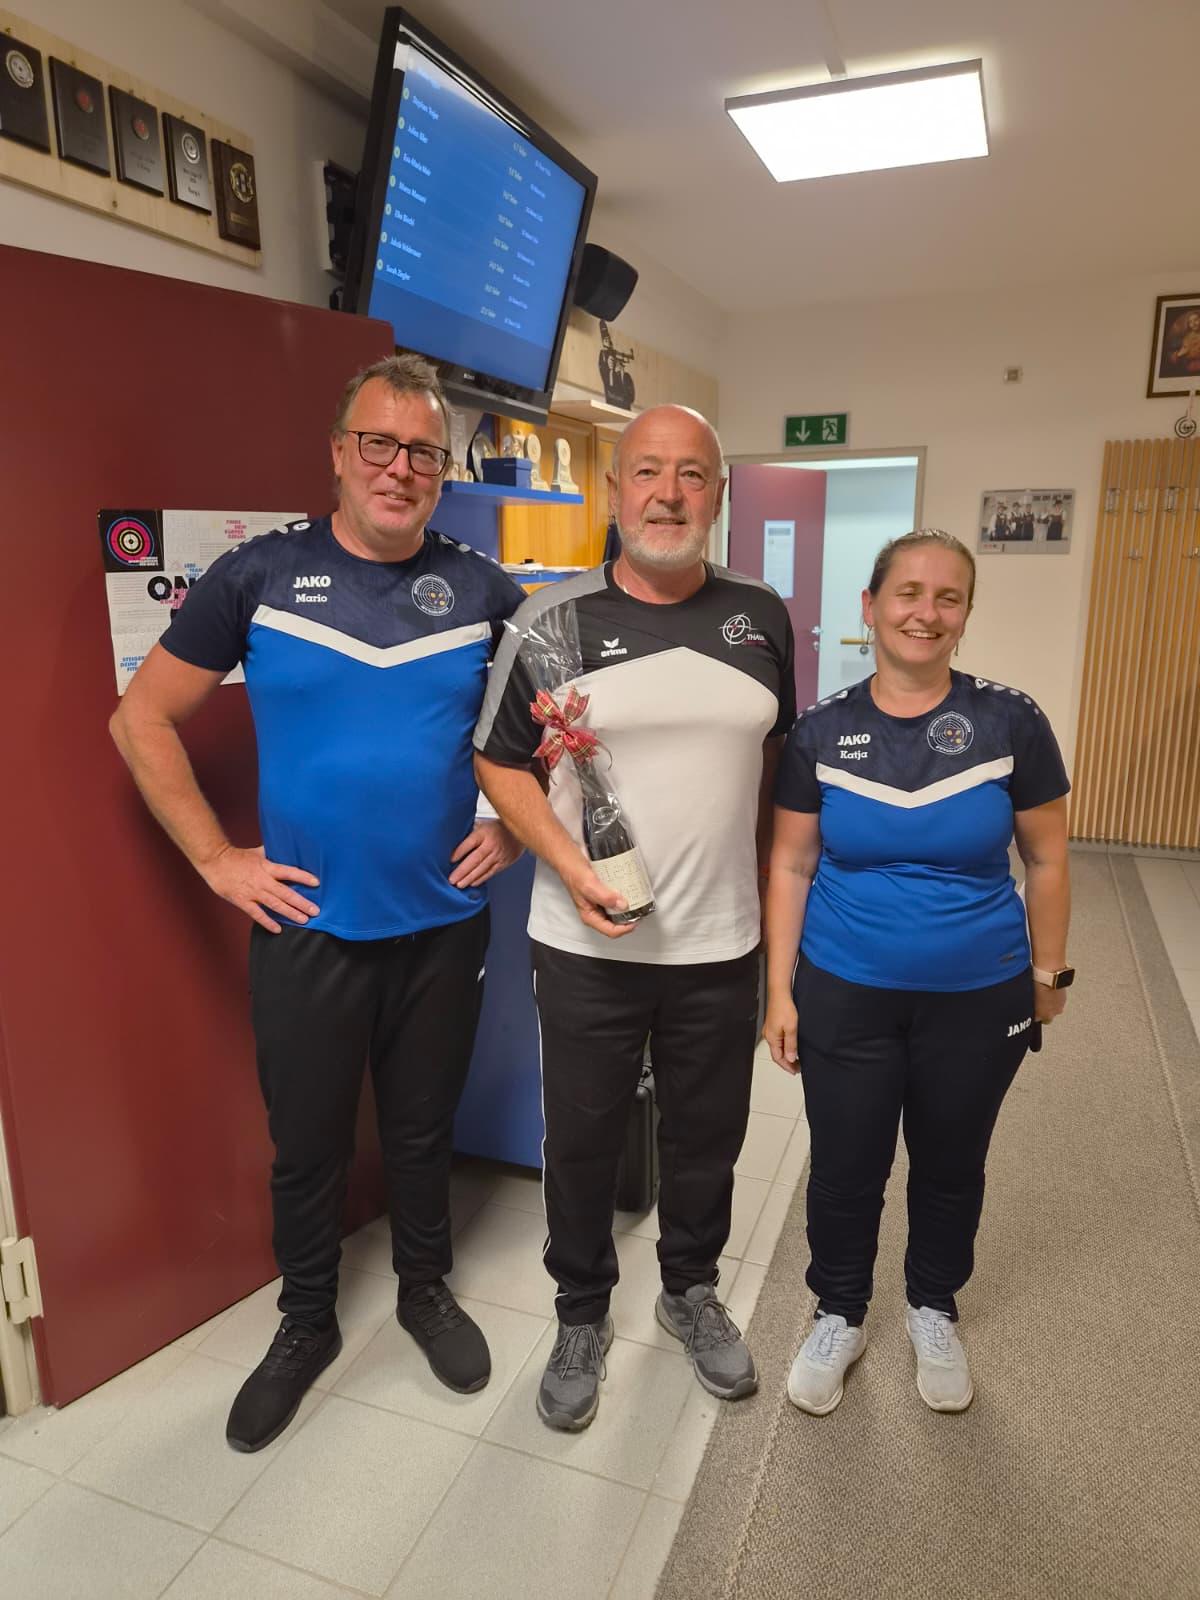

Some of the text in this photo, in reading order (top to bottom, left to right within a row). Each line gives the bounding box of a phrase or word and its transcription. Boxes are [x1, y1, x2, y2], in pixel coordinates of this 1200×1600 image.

[293, 575, 332, 589] JAKO
[295, 594, 328, 603] Mario
[600, 647, 628, 658] erima
[837, 733, 871, 746] JAKO
[840, 750, 868, 760] Katja
[1007, 1017, 1032, 1037] JAKO
